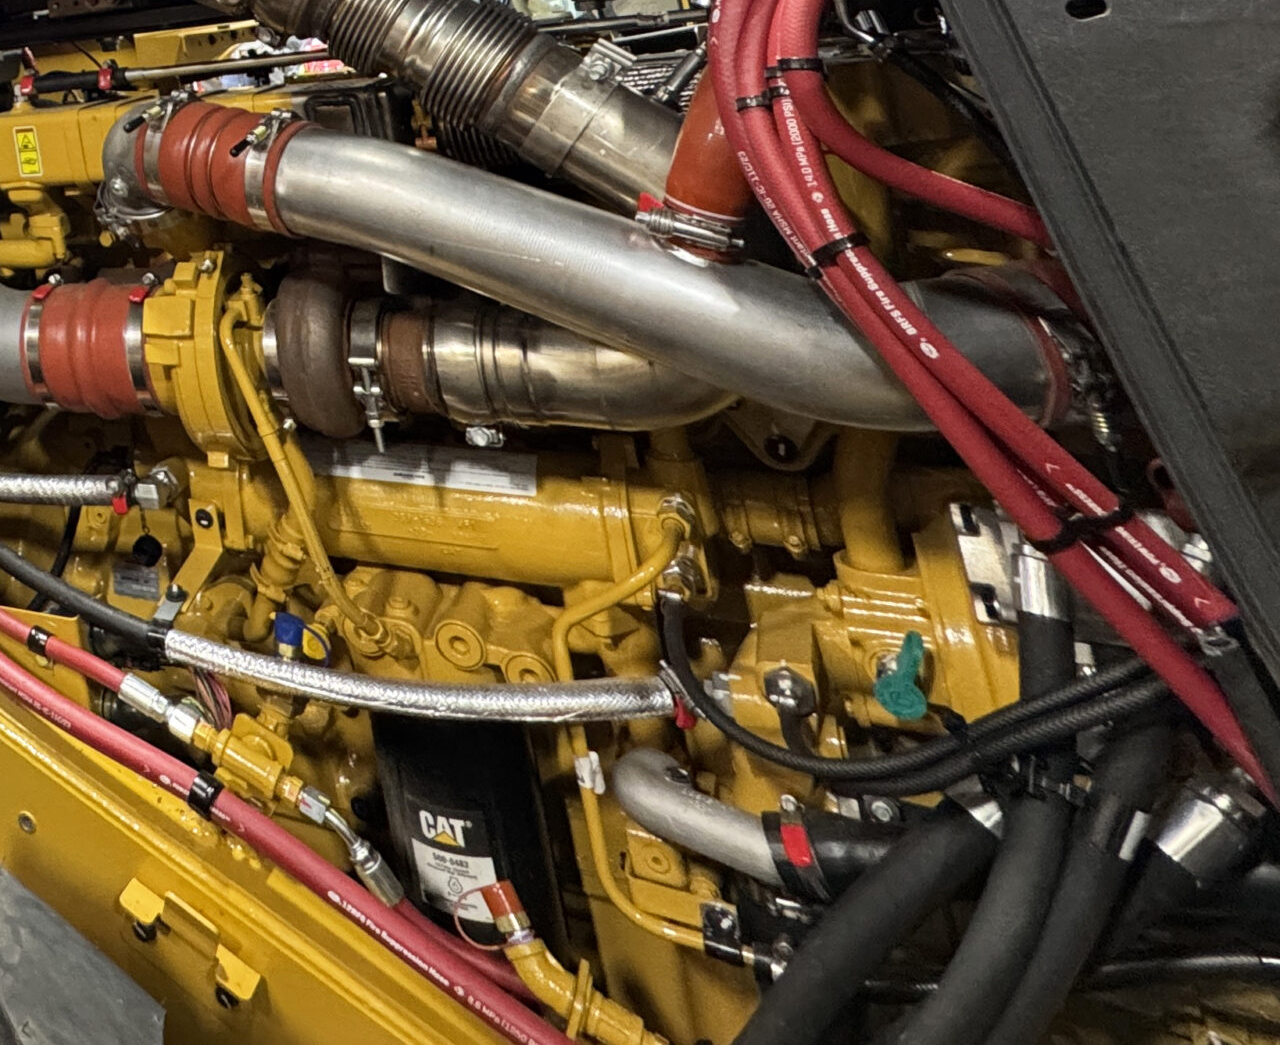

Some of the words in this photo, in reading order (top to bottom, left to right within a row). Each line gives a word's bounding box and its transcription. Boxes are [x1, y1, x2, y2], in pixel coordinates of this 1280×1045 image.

[786, 118, 804, 145] (2000
[795, 146, 809, 166] MPa
[801, 166, 818, 187] 14.0
[772, 210, 793, 235] MSHA
[821, 208, 839, 232] Hose
[875, 290, 895, 311] Fire
[419, 810, 466, 848] CAT
[381, 930, 428, 971] Suppression
[428, 966, 450, 987] Hose
